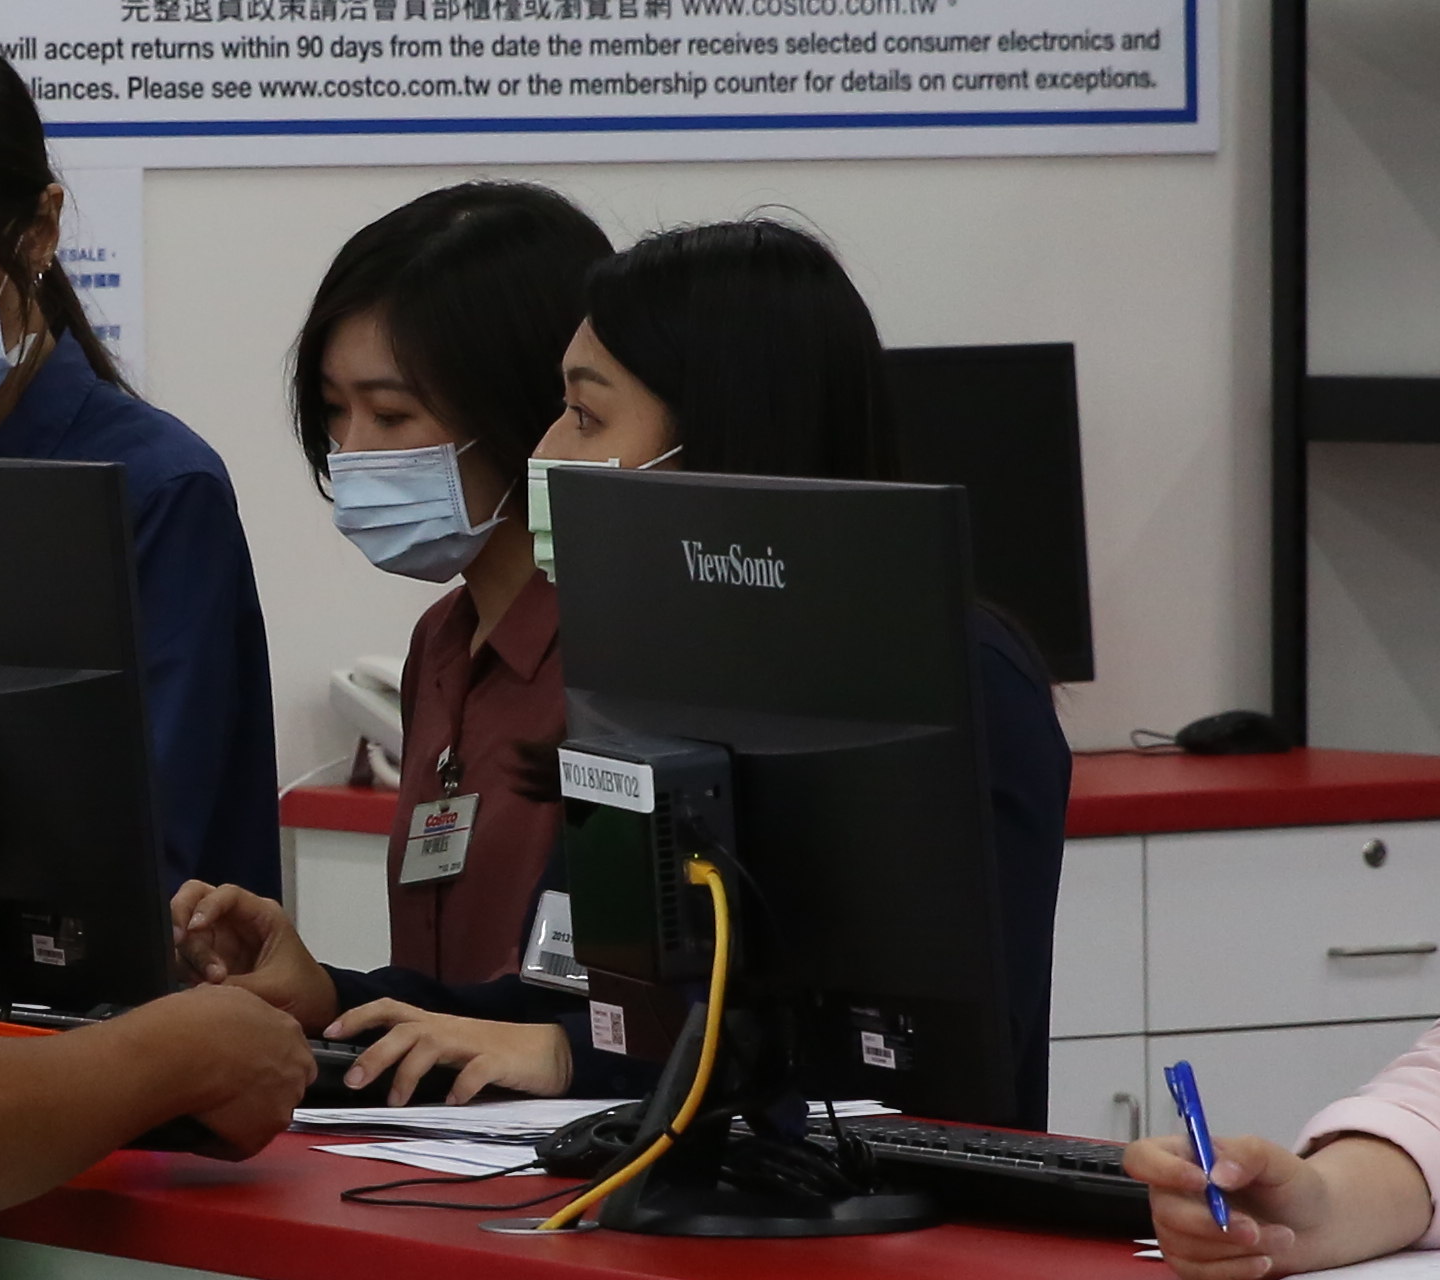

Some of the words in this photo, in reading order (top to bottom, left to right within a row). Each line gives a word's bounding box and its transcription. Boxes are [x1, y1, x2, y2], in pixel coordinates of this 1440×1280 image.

[43, 37, 125, 66] accept
[131, 37, 215, 60] returns
[220, 35, 290, 59] within
[296, 34, 324, 59] 90
[329, 34, 384, 64] days
[389, 34, 443, 58] from
[448, 34, 485, 58] the
[491, 33, 541, 58] date
[547, 33, 583, 57] the
[589, 32, 682, 57] member
[687, 31, 779, 56] receives
[784, 30, 878, 55] selected
[883, 34, 993, 54] consumer
[996, 28, 1116, 53] electronics
[1120, 27, 1162, 52] and
[681, 539, 787, 589] ViewSonic
[561, 761, 640, 799] W018MBW02
